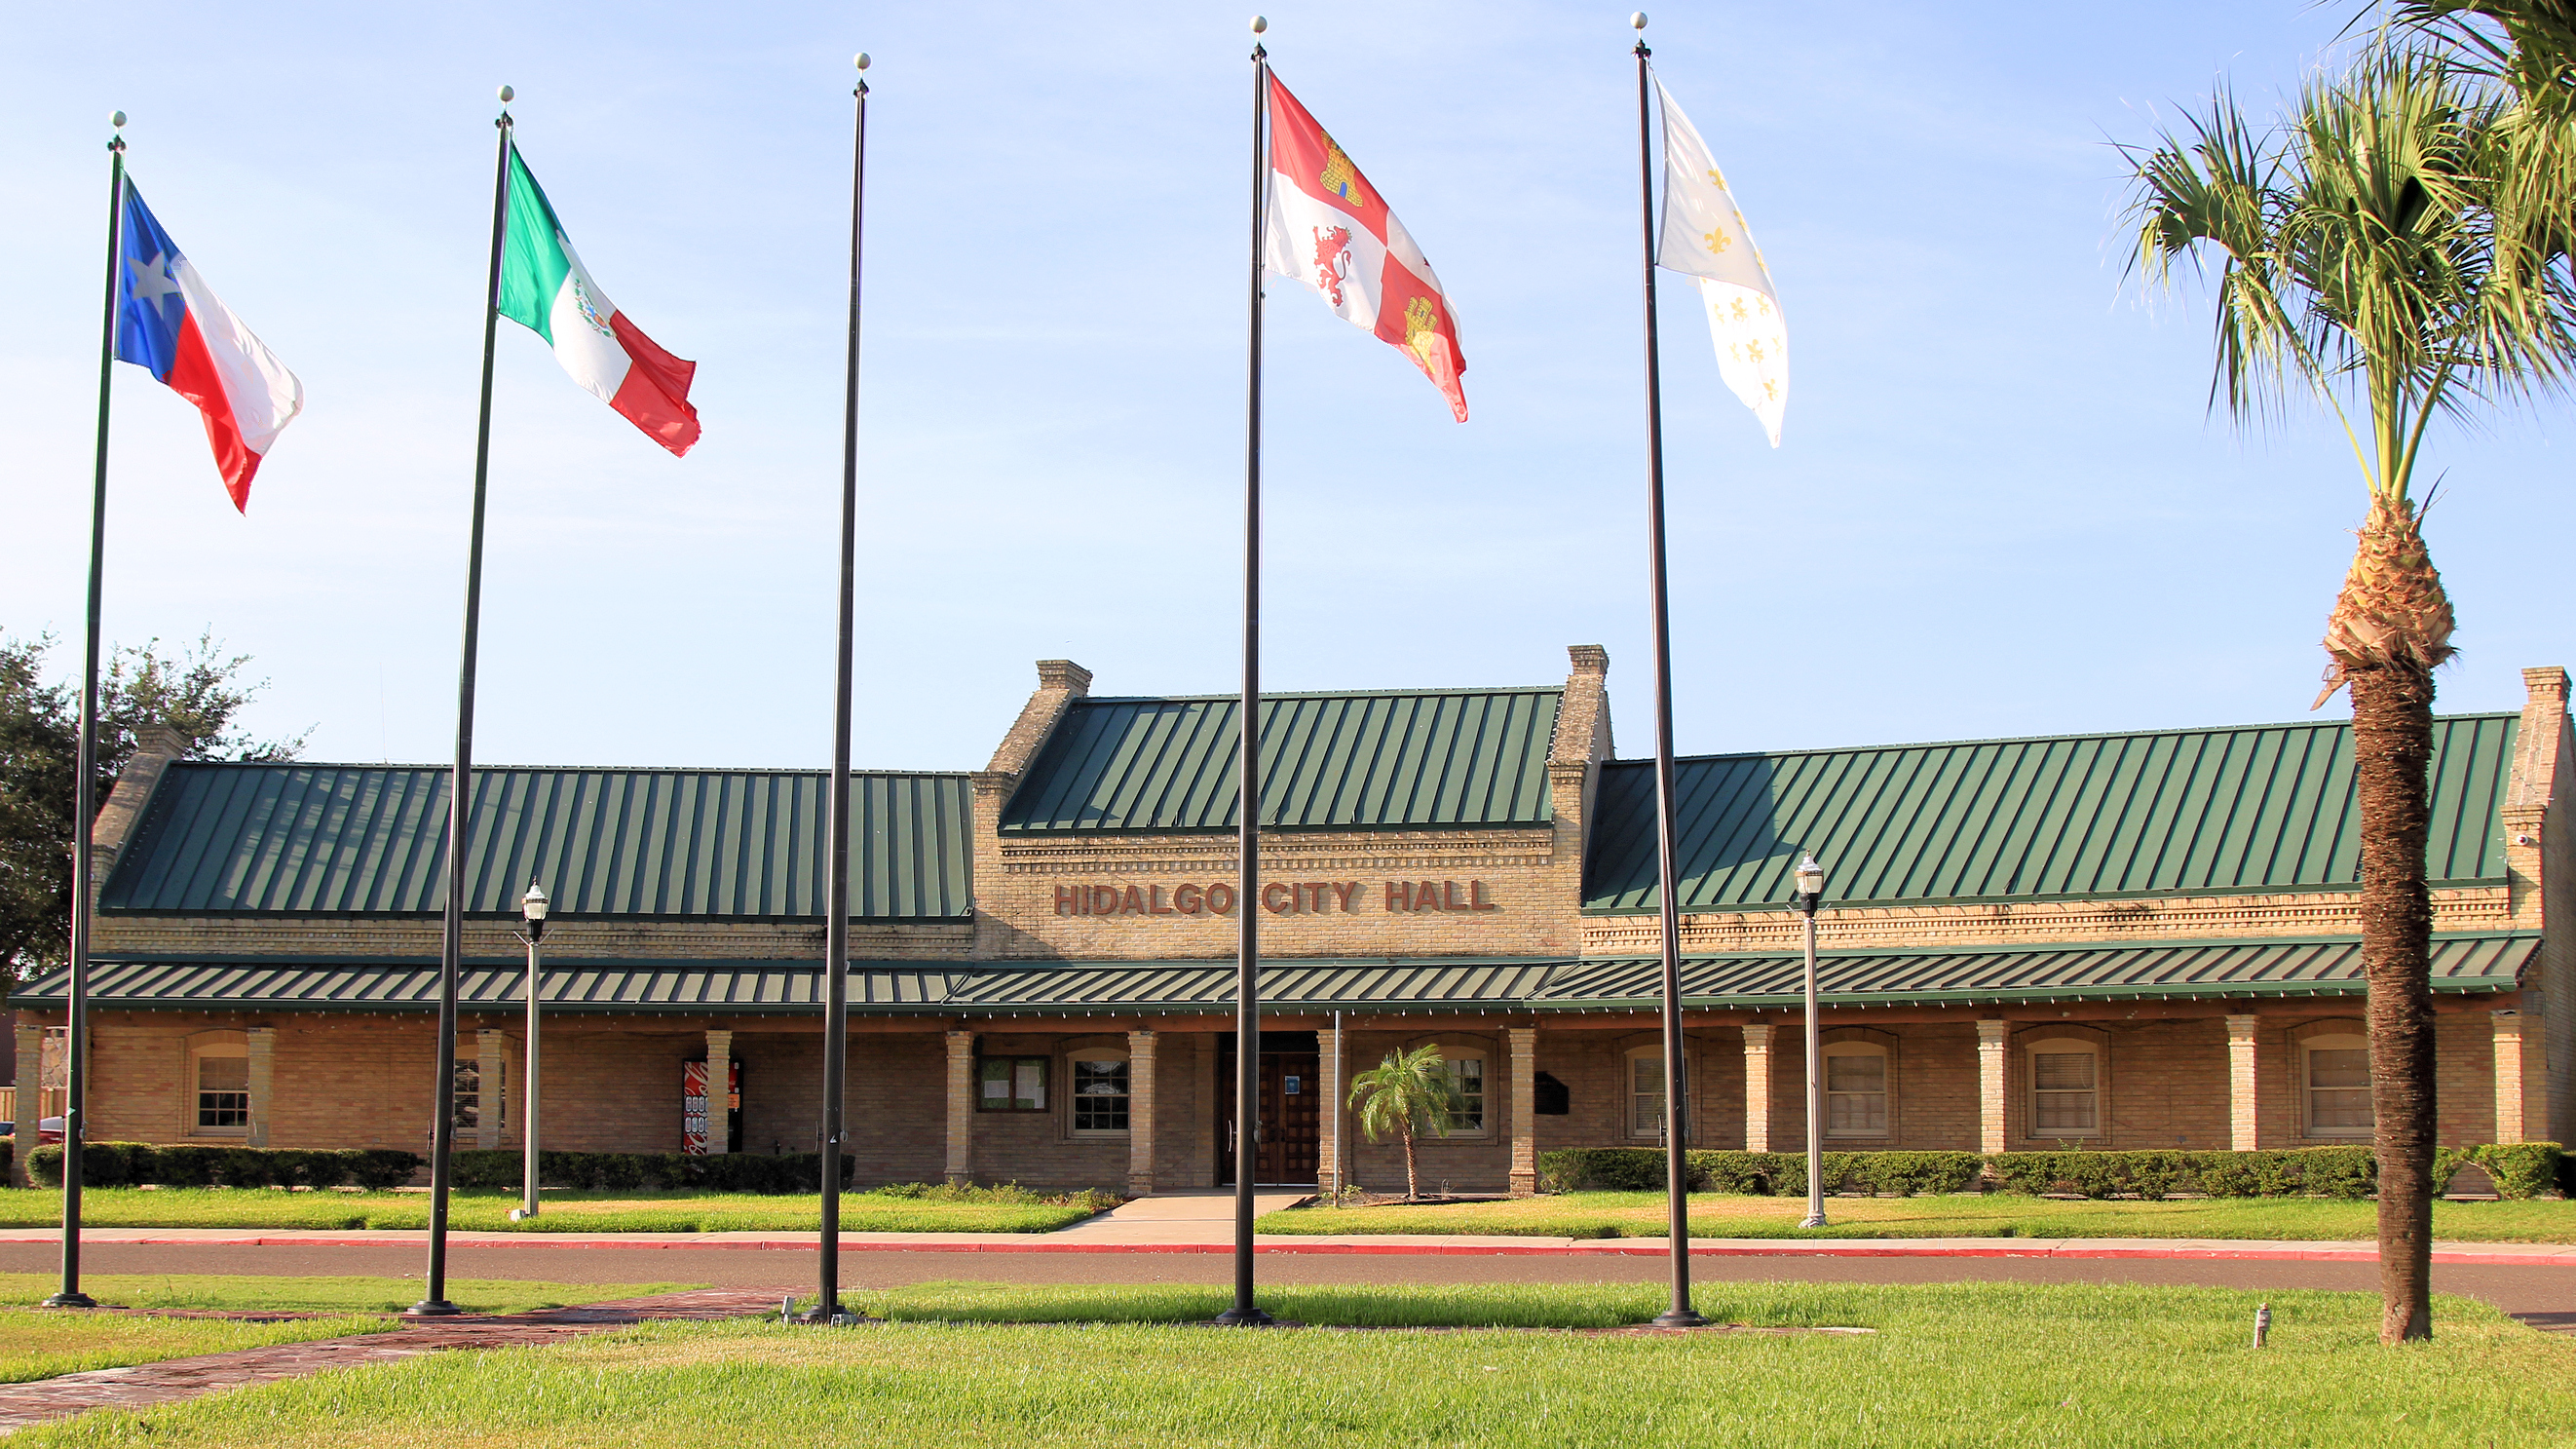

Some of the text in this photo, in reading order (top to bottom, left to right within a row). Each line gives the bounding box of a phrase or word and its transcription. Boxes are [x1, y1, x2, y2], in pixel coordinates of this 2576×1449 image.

[1054, 880, 1495, 915] HIDALGO CITY HALL
